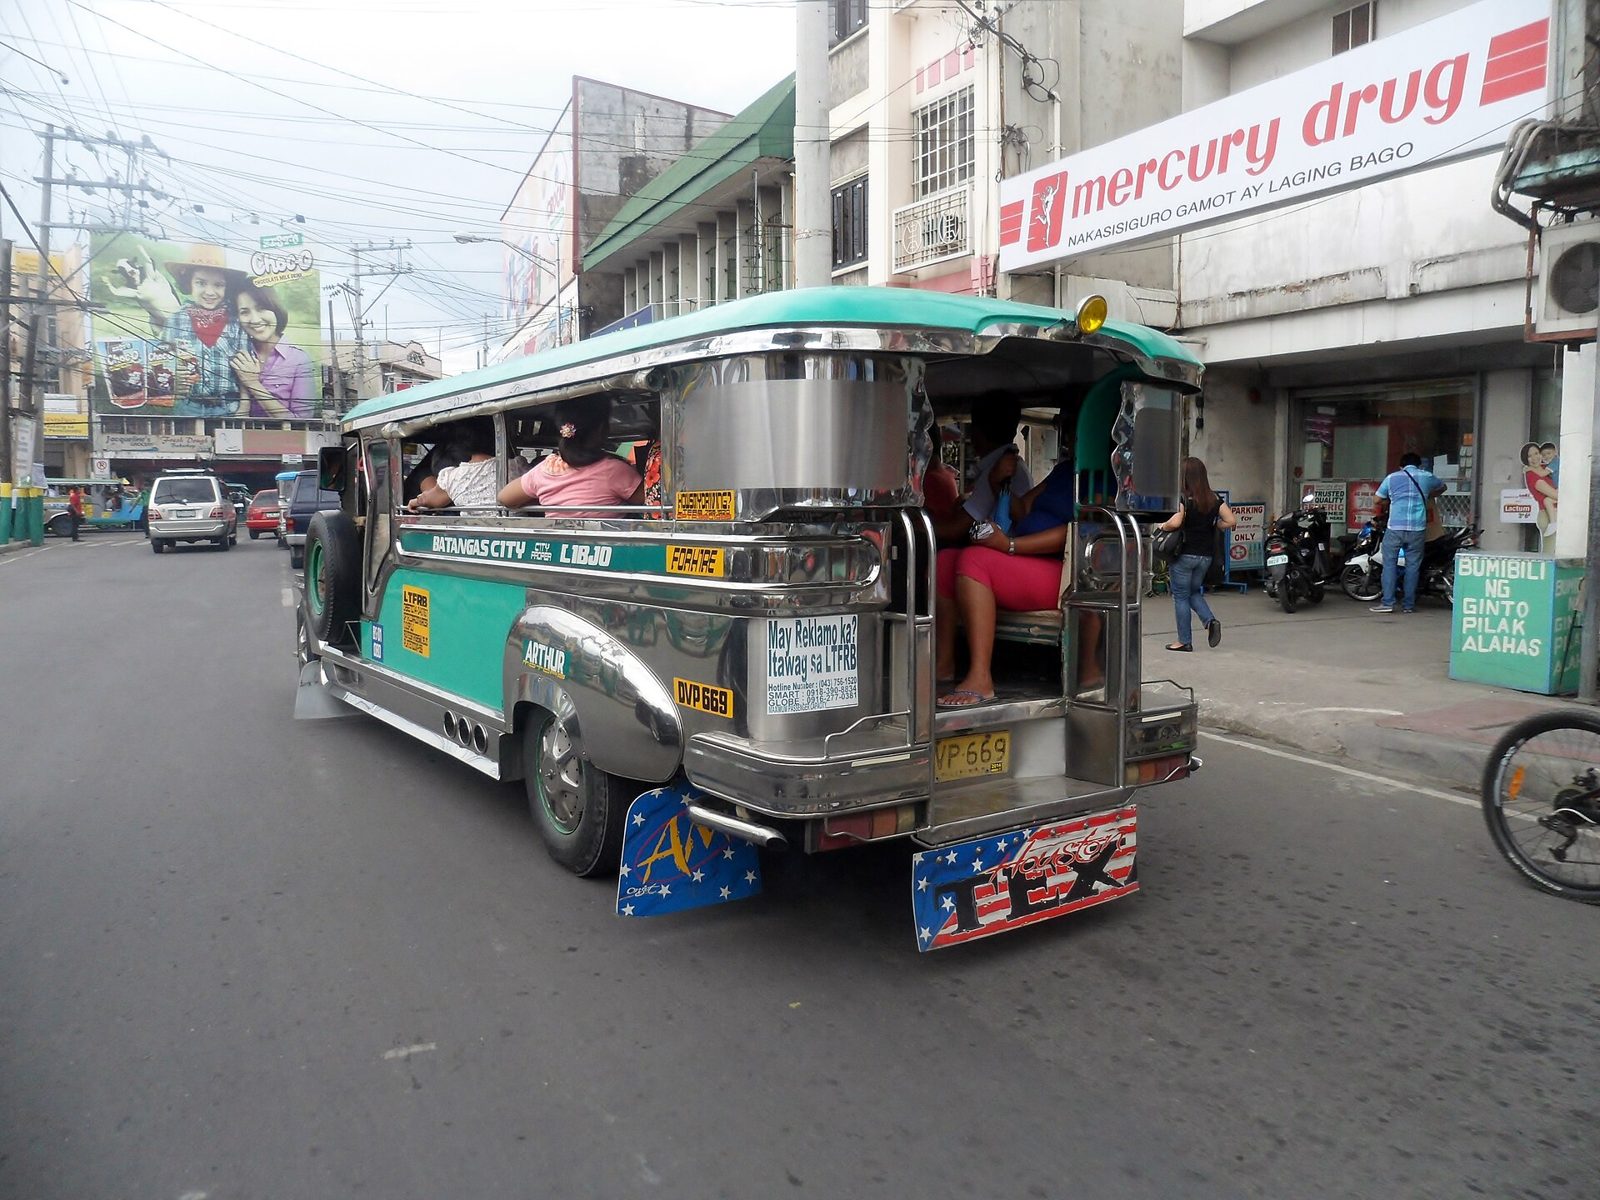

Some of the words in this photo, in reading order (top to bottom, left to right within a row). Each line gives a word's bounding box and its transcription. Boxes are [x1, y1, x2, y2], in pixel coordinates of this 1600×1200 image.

[1071, 117, 1281, 219] mercury
[1301, 52, 1470, 147] drug
[1068, 209, 1172, 247] NAKASISIGURO
[1176, 190, 1236, 218] GAMOT
[1240, 182, 1264, 201] AY
[1269, 162, 1342, 193] LAGING
[1349, 142, 1414, 171] BAGO
[1231, 506, 1263, 515] PARKING
[432, 536, 490, 556] BATANGAS
[491, 541, 526, 559] CITY
[1234, 533, 1256, 541] ONLY
[1458, 556, 1546, 580] BUMIBILI
[1485, 579, 1510, 598] NG
[1462, 597, 1529, 618] GINTO
[768, 620, 792, 656] May
[795, 618, 838, 648] Reklamo
[840, 615, 857, 644] ka?
[1461, 616, 1526, 636] PILAK
[1461, 635, 1542, 657] ALAHAS
[525, 640, 566, 675] ARTHUR
[768, 649, 808, 682] Itawag
[811, 653, 822, 673] sa
[825, 643, 857, 672] LTFRB
[678, 680, 701, 707] DVP
[702, 686, 728, 714] 669
[768, 683, 791, 691] Hotline
[768, 690, 799, 699] SMART
[768, 698, 799, 707] GLOBE
